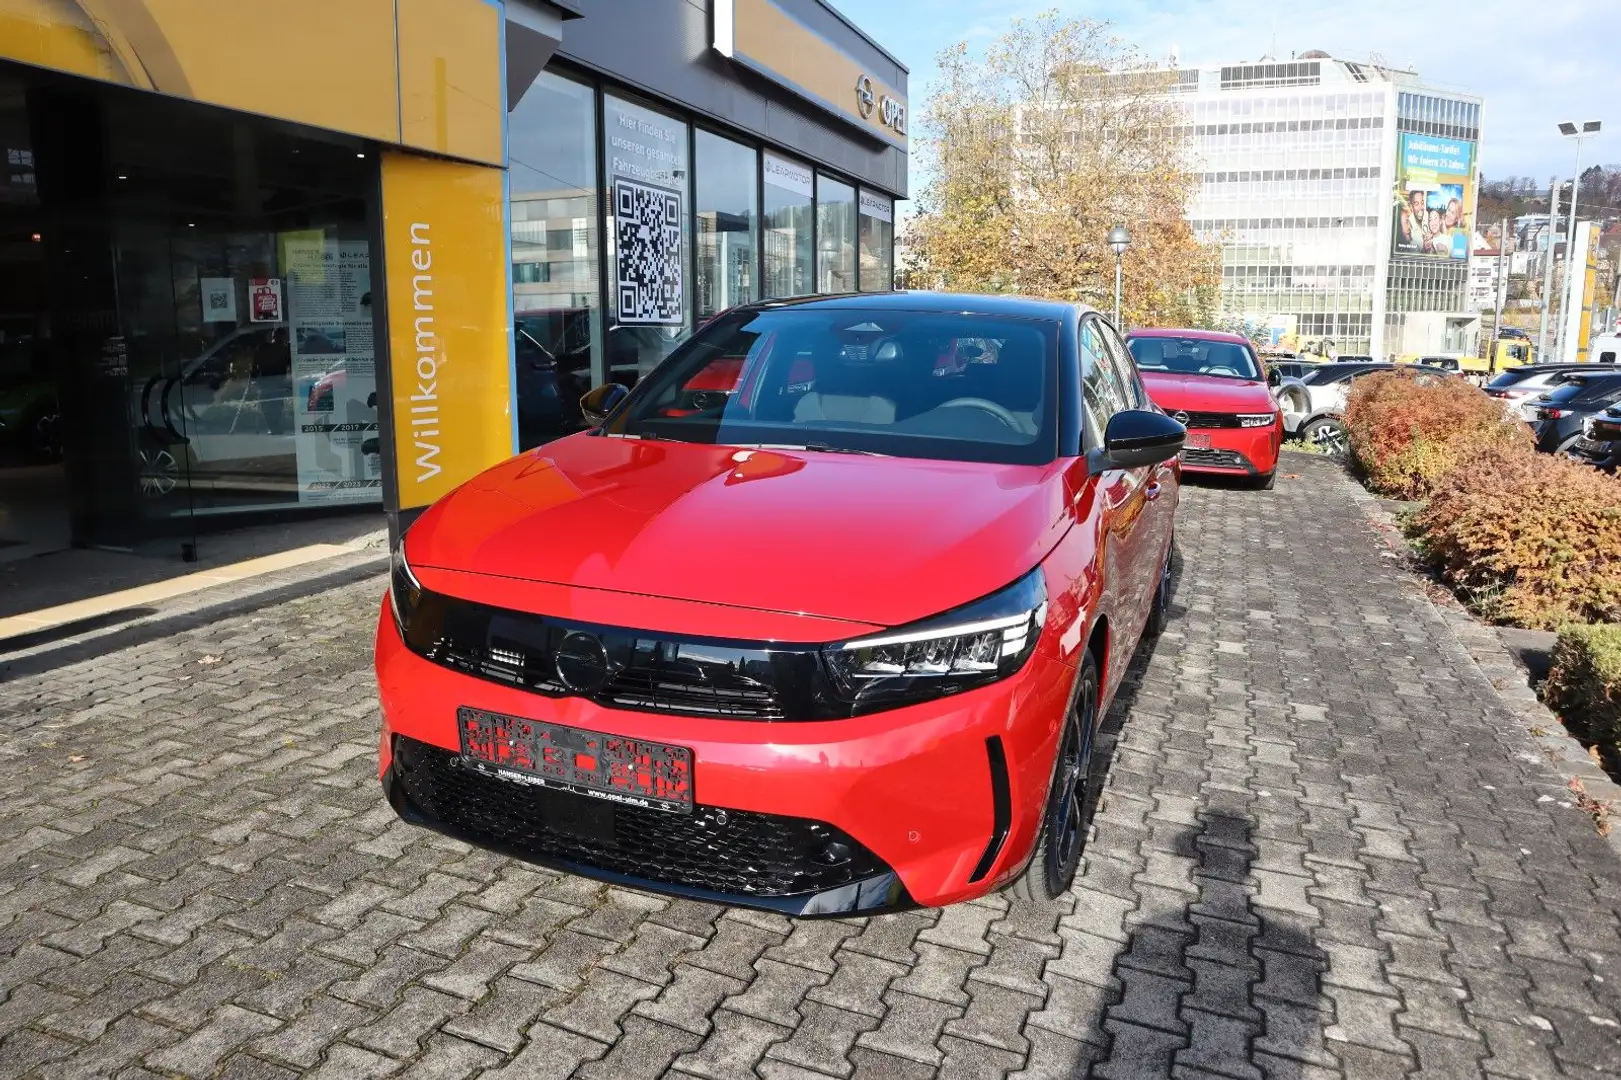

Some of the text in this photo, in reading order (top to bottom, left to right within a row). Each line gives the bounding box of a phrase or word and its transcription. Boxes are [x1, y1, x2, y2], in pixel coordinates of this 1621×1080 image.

[619, 113, 677, 145] Hier finden Sie
[611, 136, 646, 156] unseren
[772, 165, 811, 185] LEAPMOTOR
[864, 198, 890, 213] LEAPMOTOR
[410, 222, 441, 483] Willkommen
[587, 789, 649, 808] www.opel-ulm.de
